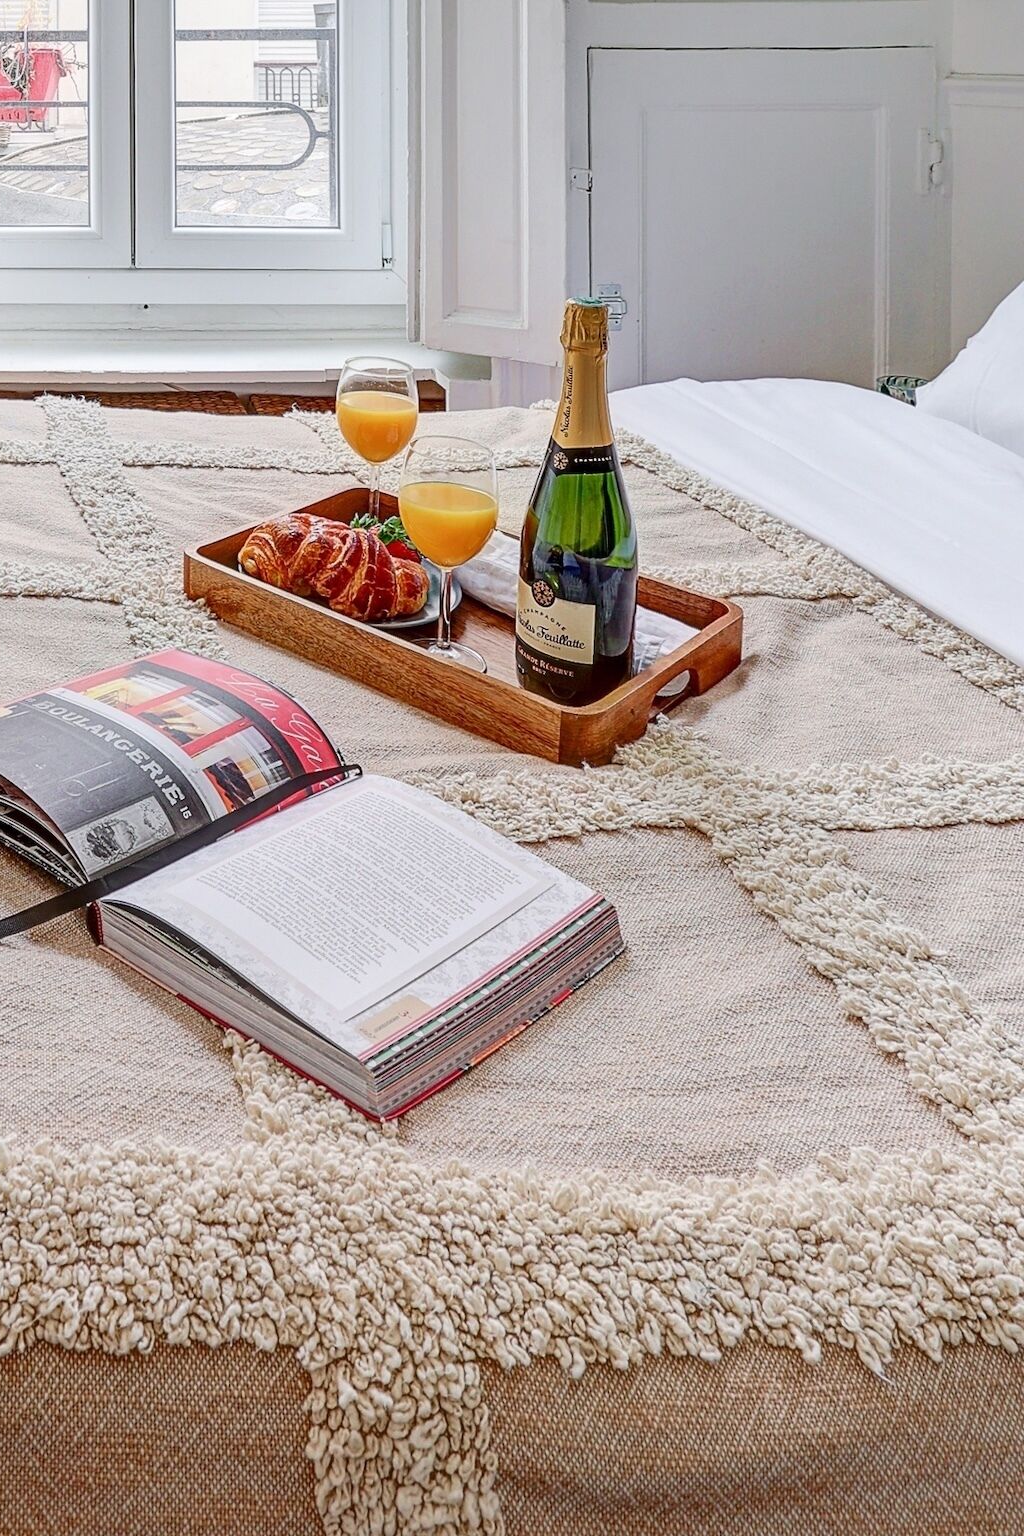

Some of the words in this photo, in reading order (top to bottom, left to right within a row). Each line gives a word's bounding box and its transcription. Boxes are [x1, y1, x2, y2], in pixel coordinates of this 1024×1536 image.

[560, 406, 570, 438] Nicolas
[536, 625, 586, 650] Feuillatte
[517, 644, 539, 666] GRANDE
[31, 700, 186, 806] BOULANGERIE
